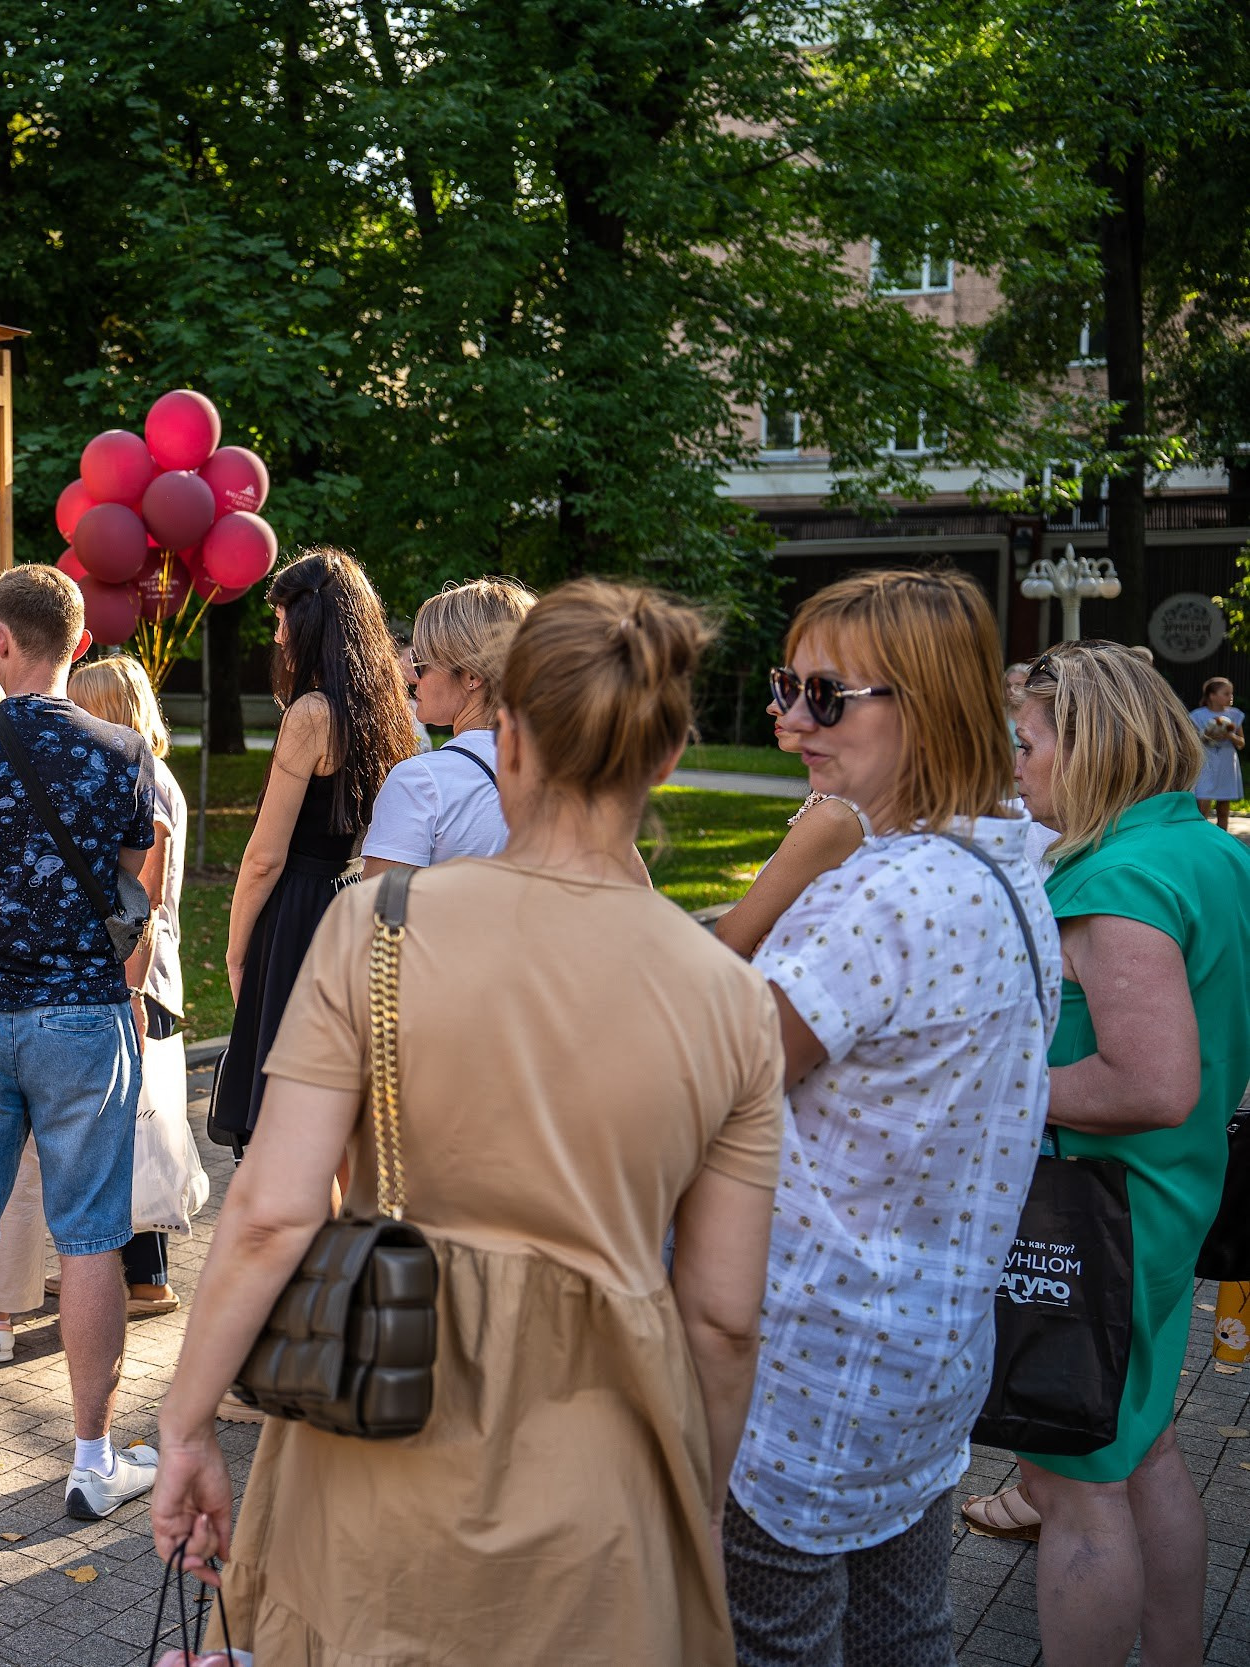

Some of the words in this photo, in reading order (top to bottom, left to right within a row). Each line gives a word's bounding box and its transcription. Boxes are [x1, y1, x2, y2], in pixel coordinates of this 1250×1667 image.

[1013, 1239, 1026, 1247] ть
[1028, 1240, 1046, 1250] как
[1049, 1243, 1075, 1255] гуру?
[1004, 1252, 1081, 1276] УНЦОМ
[997, 1272, 1070, 1299] АГУРО
